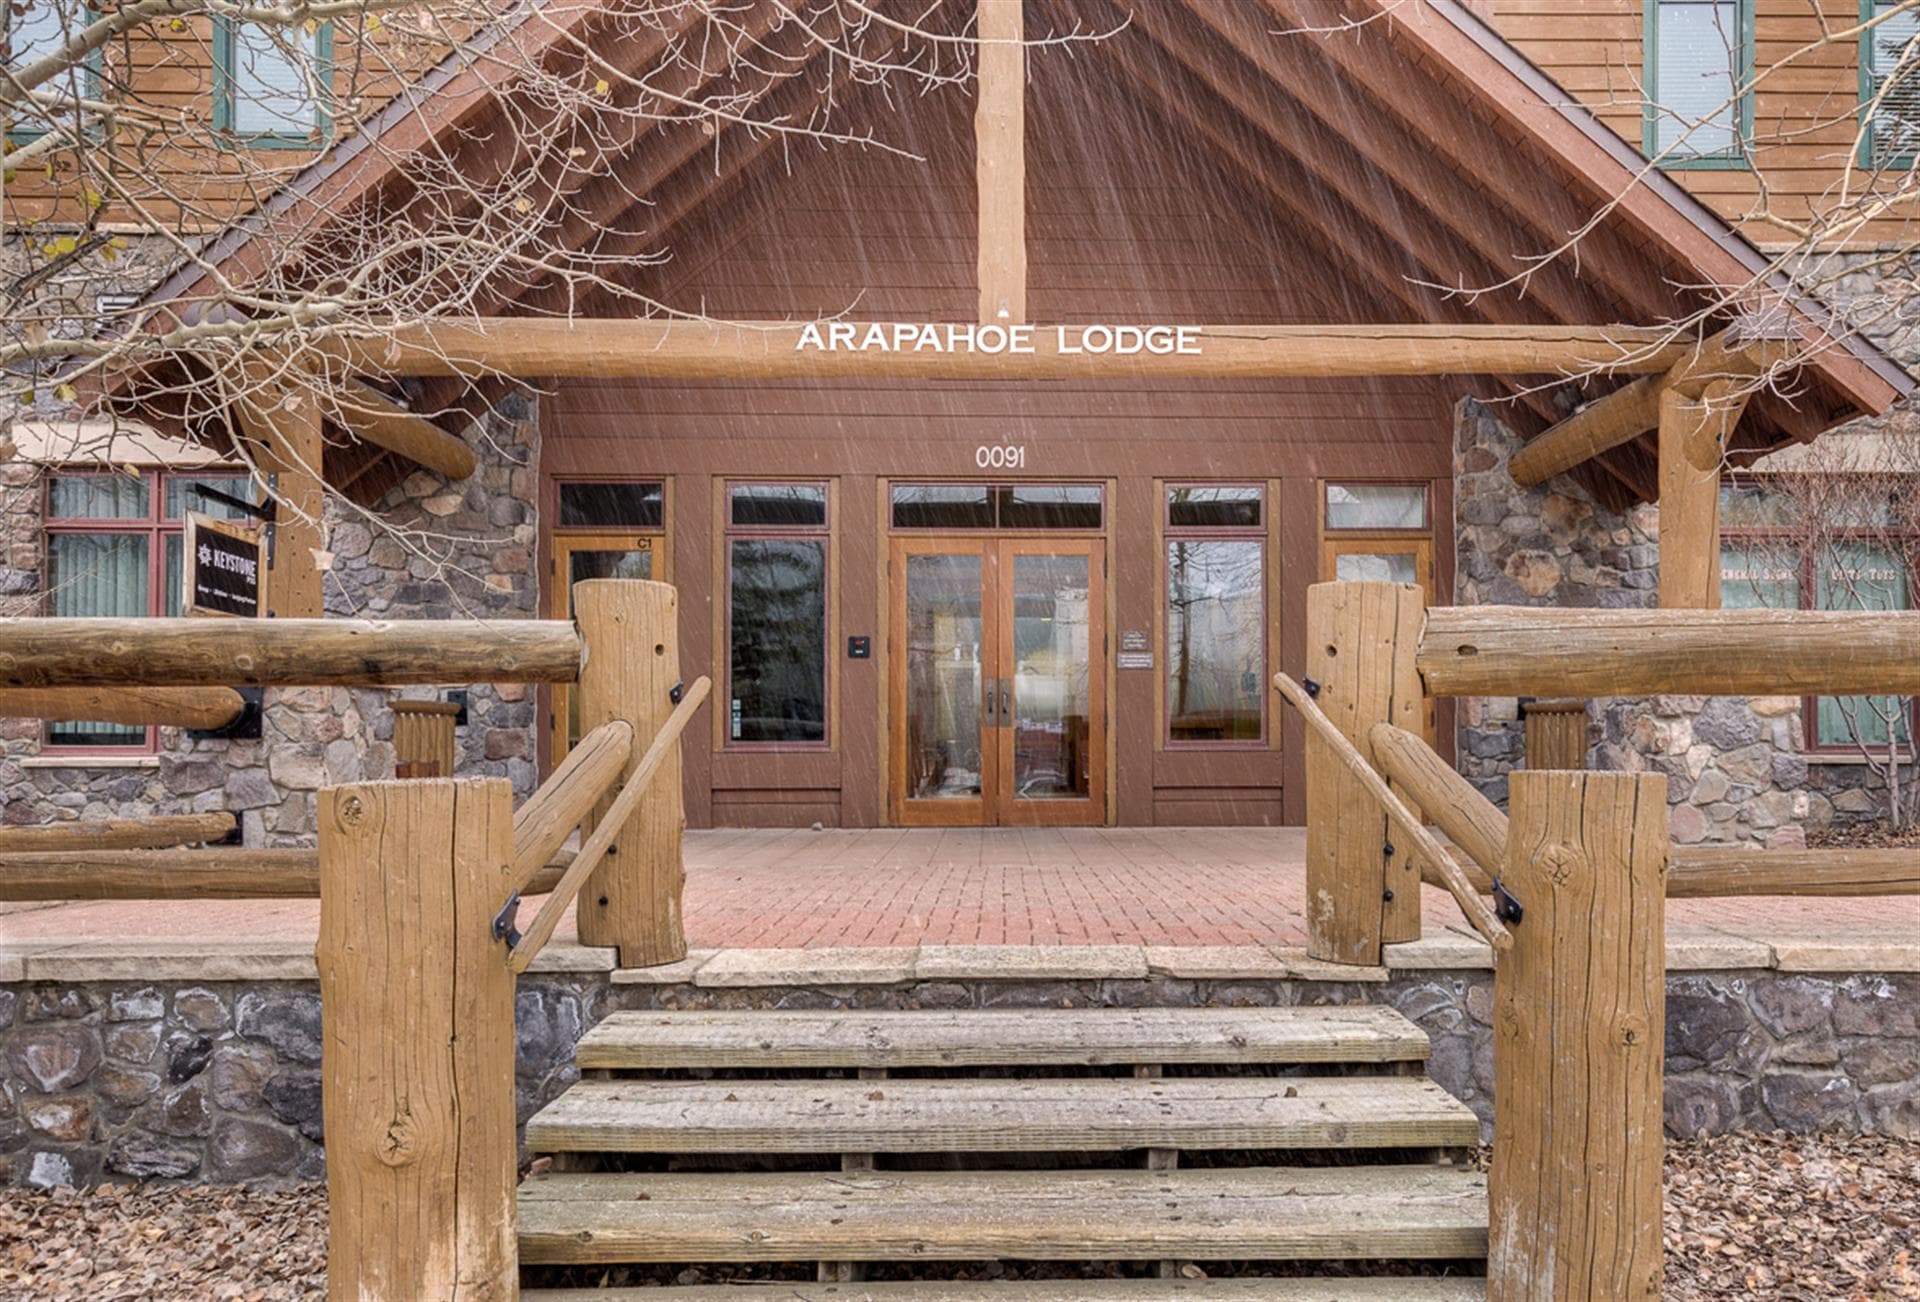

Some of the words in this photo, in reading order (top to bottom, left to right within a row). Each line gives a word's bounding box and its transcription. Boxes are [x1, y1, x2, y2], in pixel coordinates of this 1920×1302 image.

[796, 323, 1036, 354] ARAPAHOE
[1057, 325, 1203, 355] LODGE
[976, 446, 1025, 469] 0091
[637, 537, 652, 549] C1
[214, 549, 257, 578] KEYSTONE
[1721, 569, 1760, 580] ENERAL
